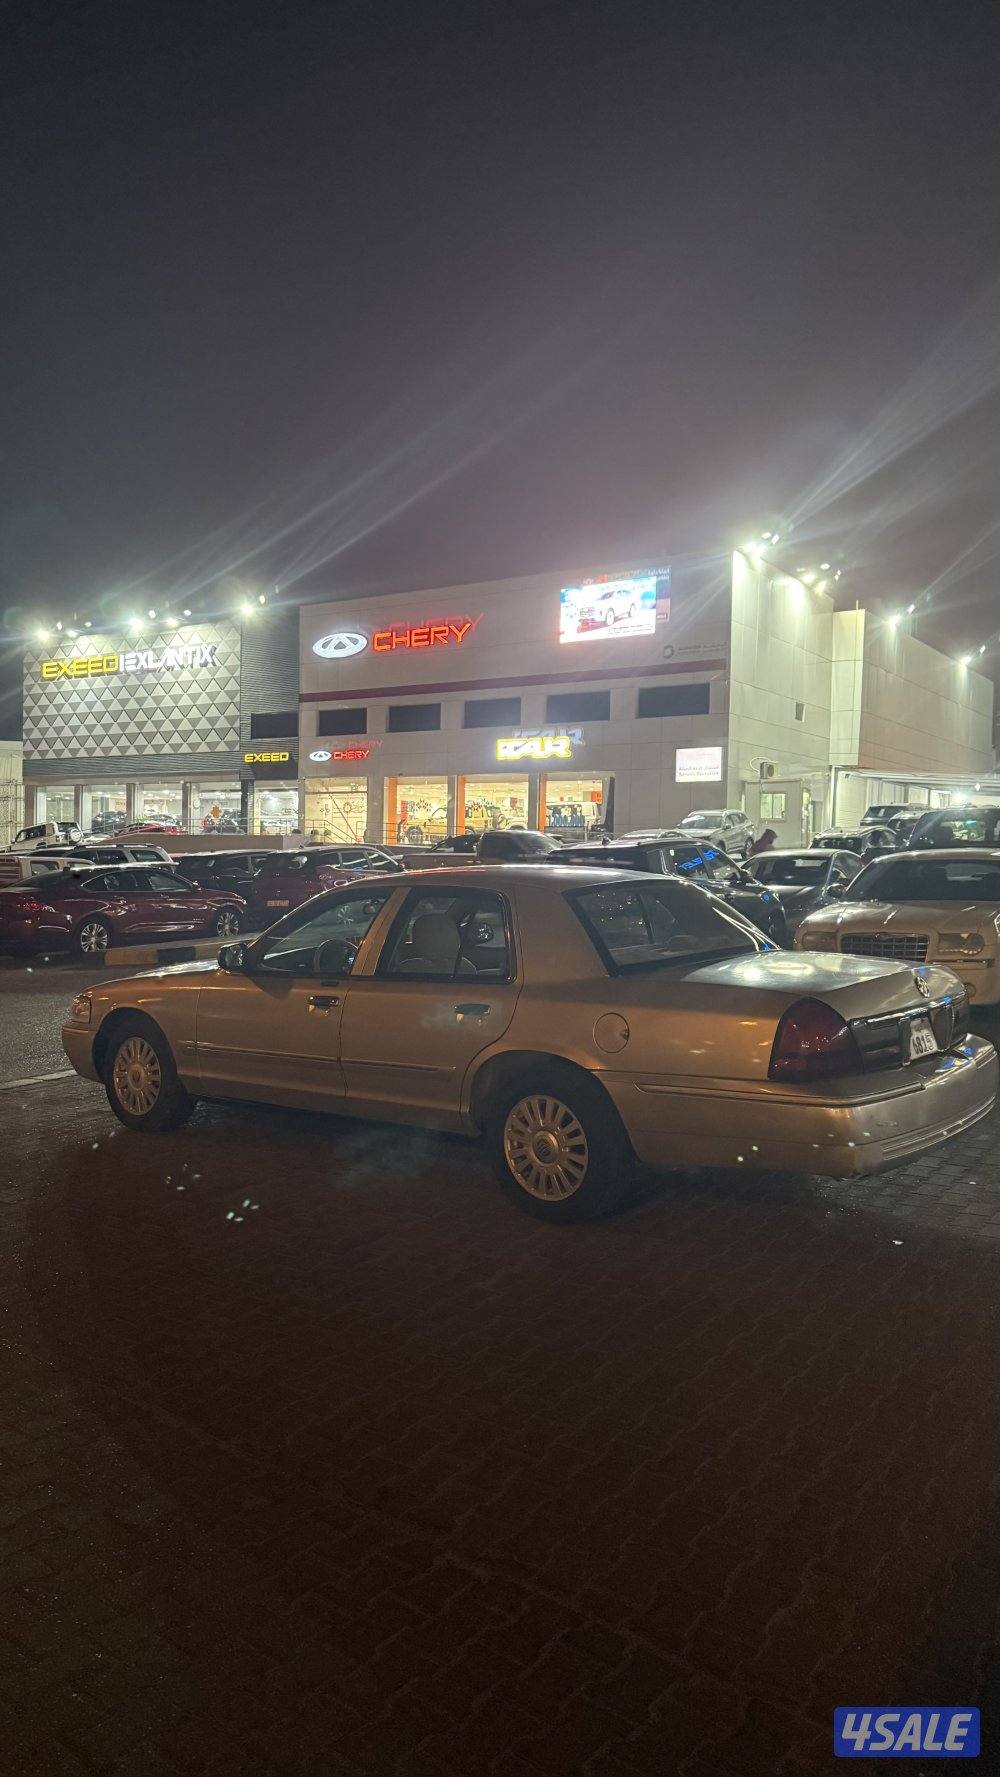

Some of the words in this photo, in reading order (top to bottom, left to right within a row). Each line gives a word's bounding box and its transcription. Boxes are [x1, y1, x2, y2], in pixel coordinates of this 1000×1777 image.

[373, 623, 471, 651] CHERY
[41, 654, 119, 679] EXEED
[124, 644, 214, 671] EXLANTIX
[244, 752, 289, 763] EXEED
[333, 749, 370, 760] CHERY
